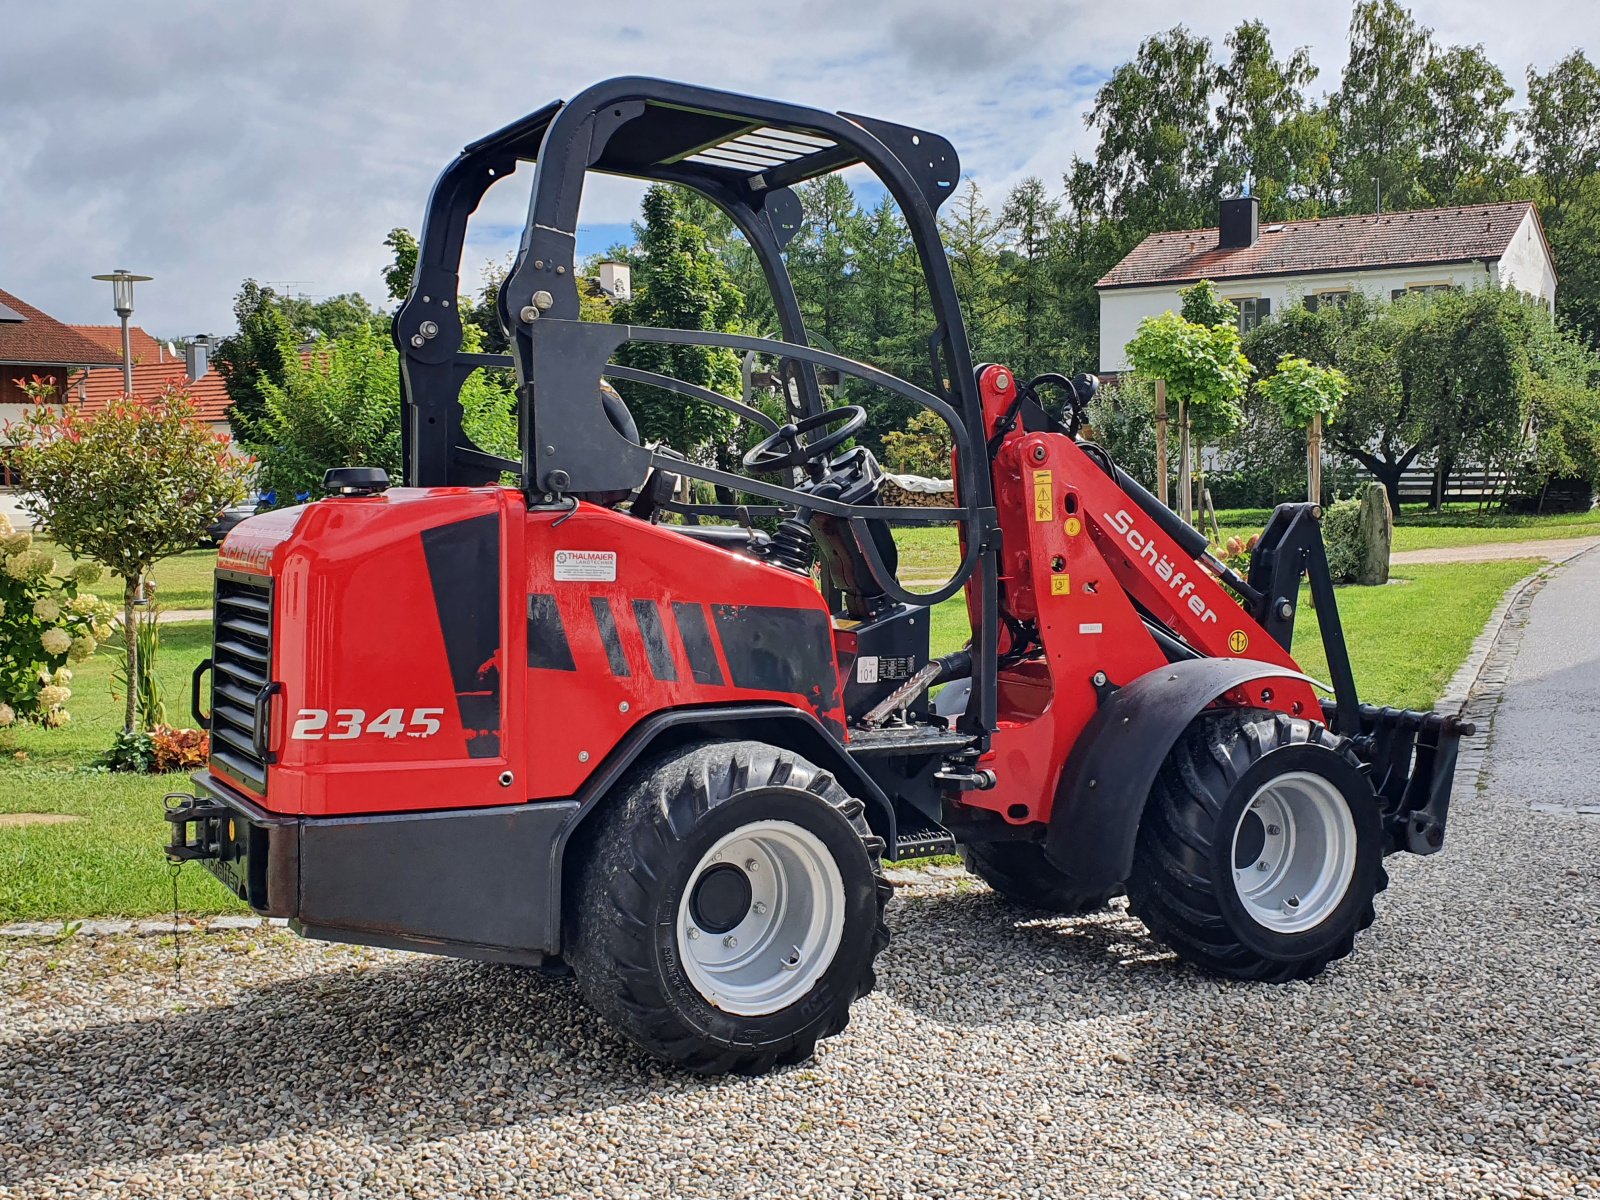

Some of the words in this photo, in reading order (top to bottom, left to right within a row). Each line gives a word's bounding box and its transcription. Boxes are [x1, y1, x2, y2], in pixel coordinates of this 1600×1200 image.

[567, 552, 614, 561] THALMAIER
[1103, 509, 1218, 624] Schäffer
[291, 708, 445, 740] 2345
